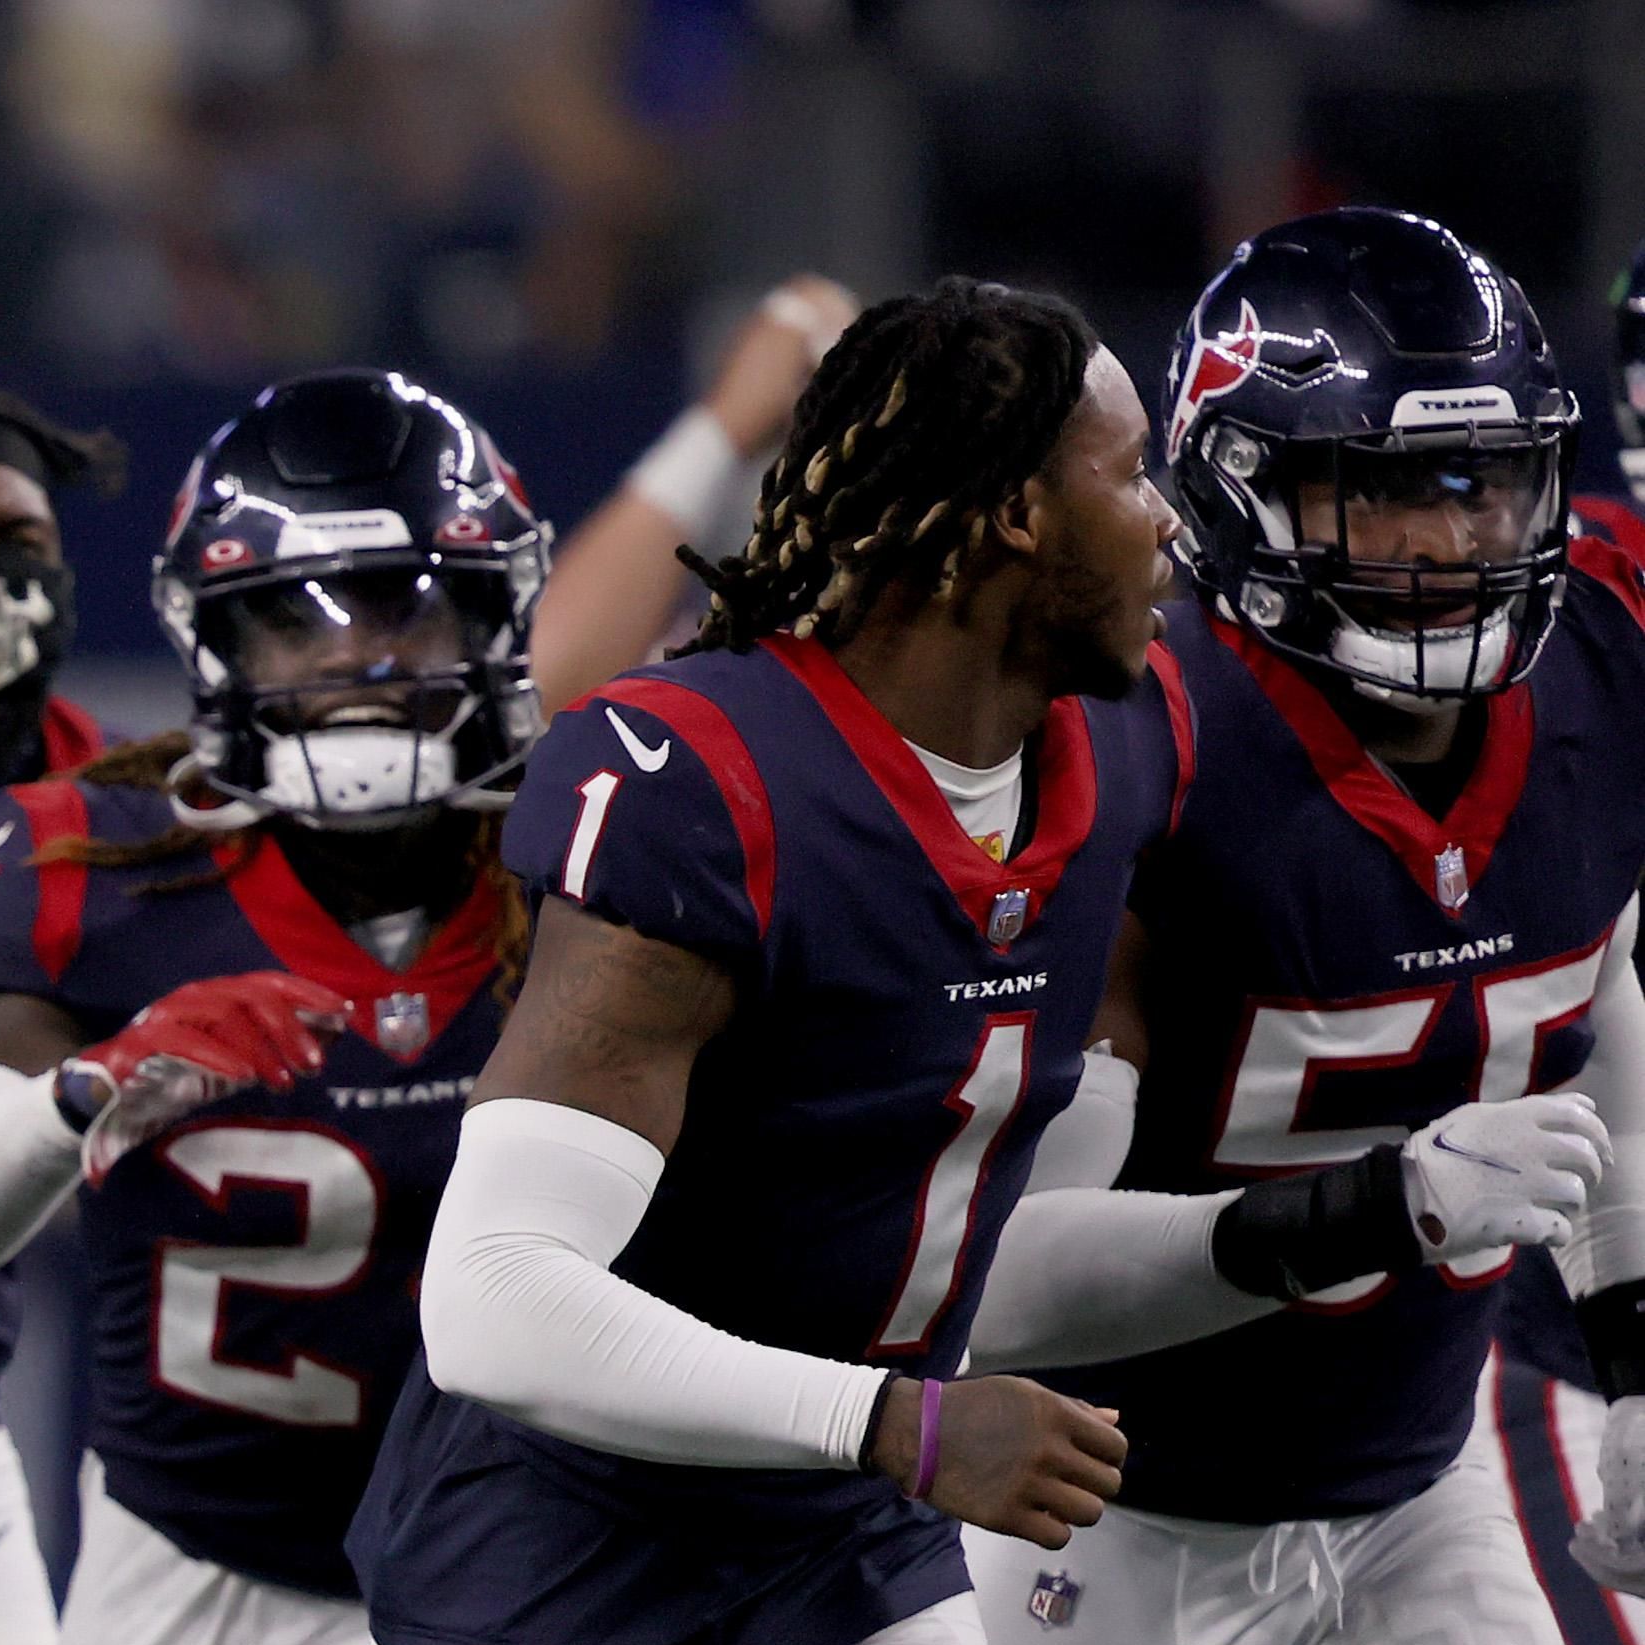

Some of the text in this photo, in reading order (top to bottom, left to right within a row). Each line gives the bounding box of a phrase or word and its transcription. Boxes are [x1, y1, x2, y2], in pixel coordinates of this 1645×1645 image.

[560, 767, 626, 905] 1
[943, 972, 1048, 1003] TEXANS
[1392, 933, 1514, 972] TEXANS
[865, 1009, 1037, 1358] 1
